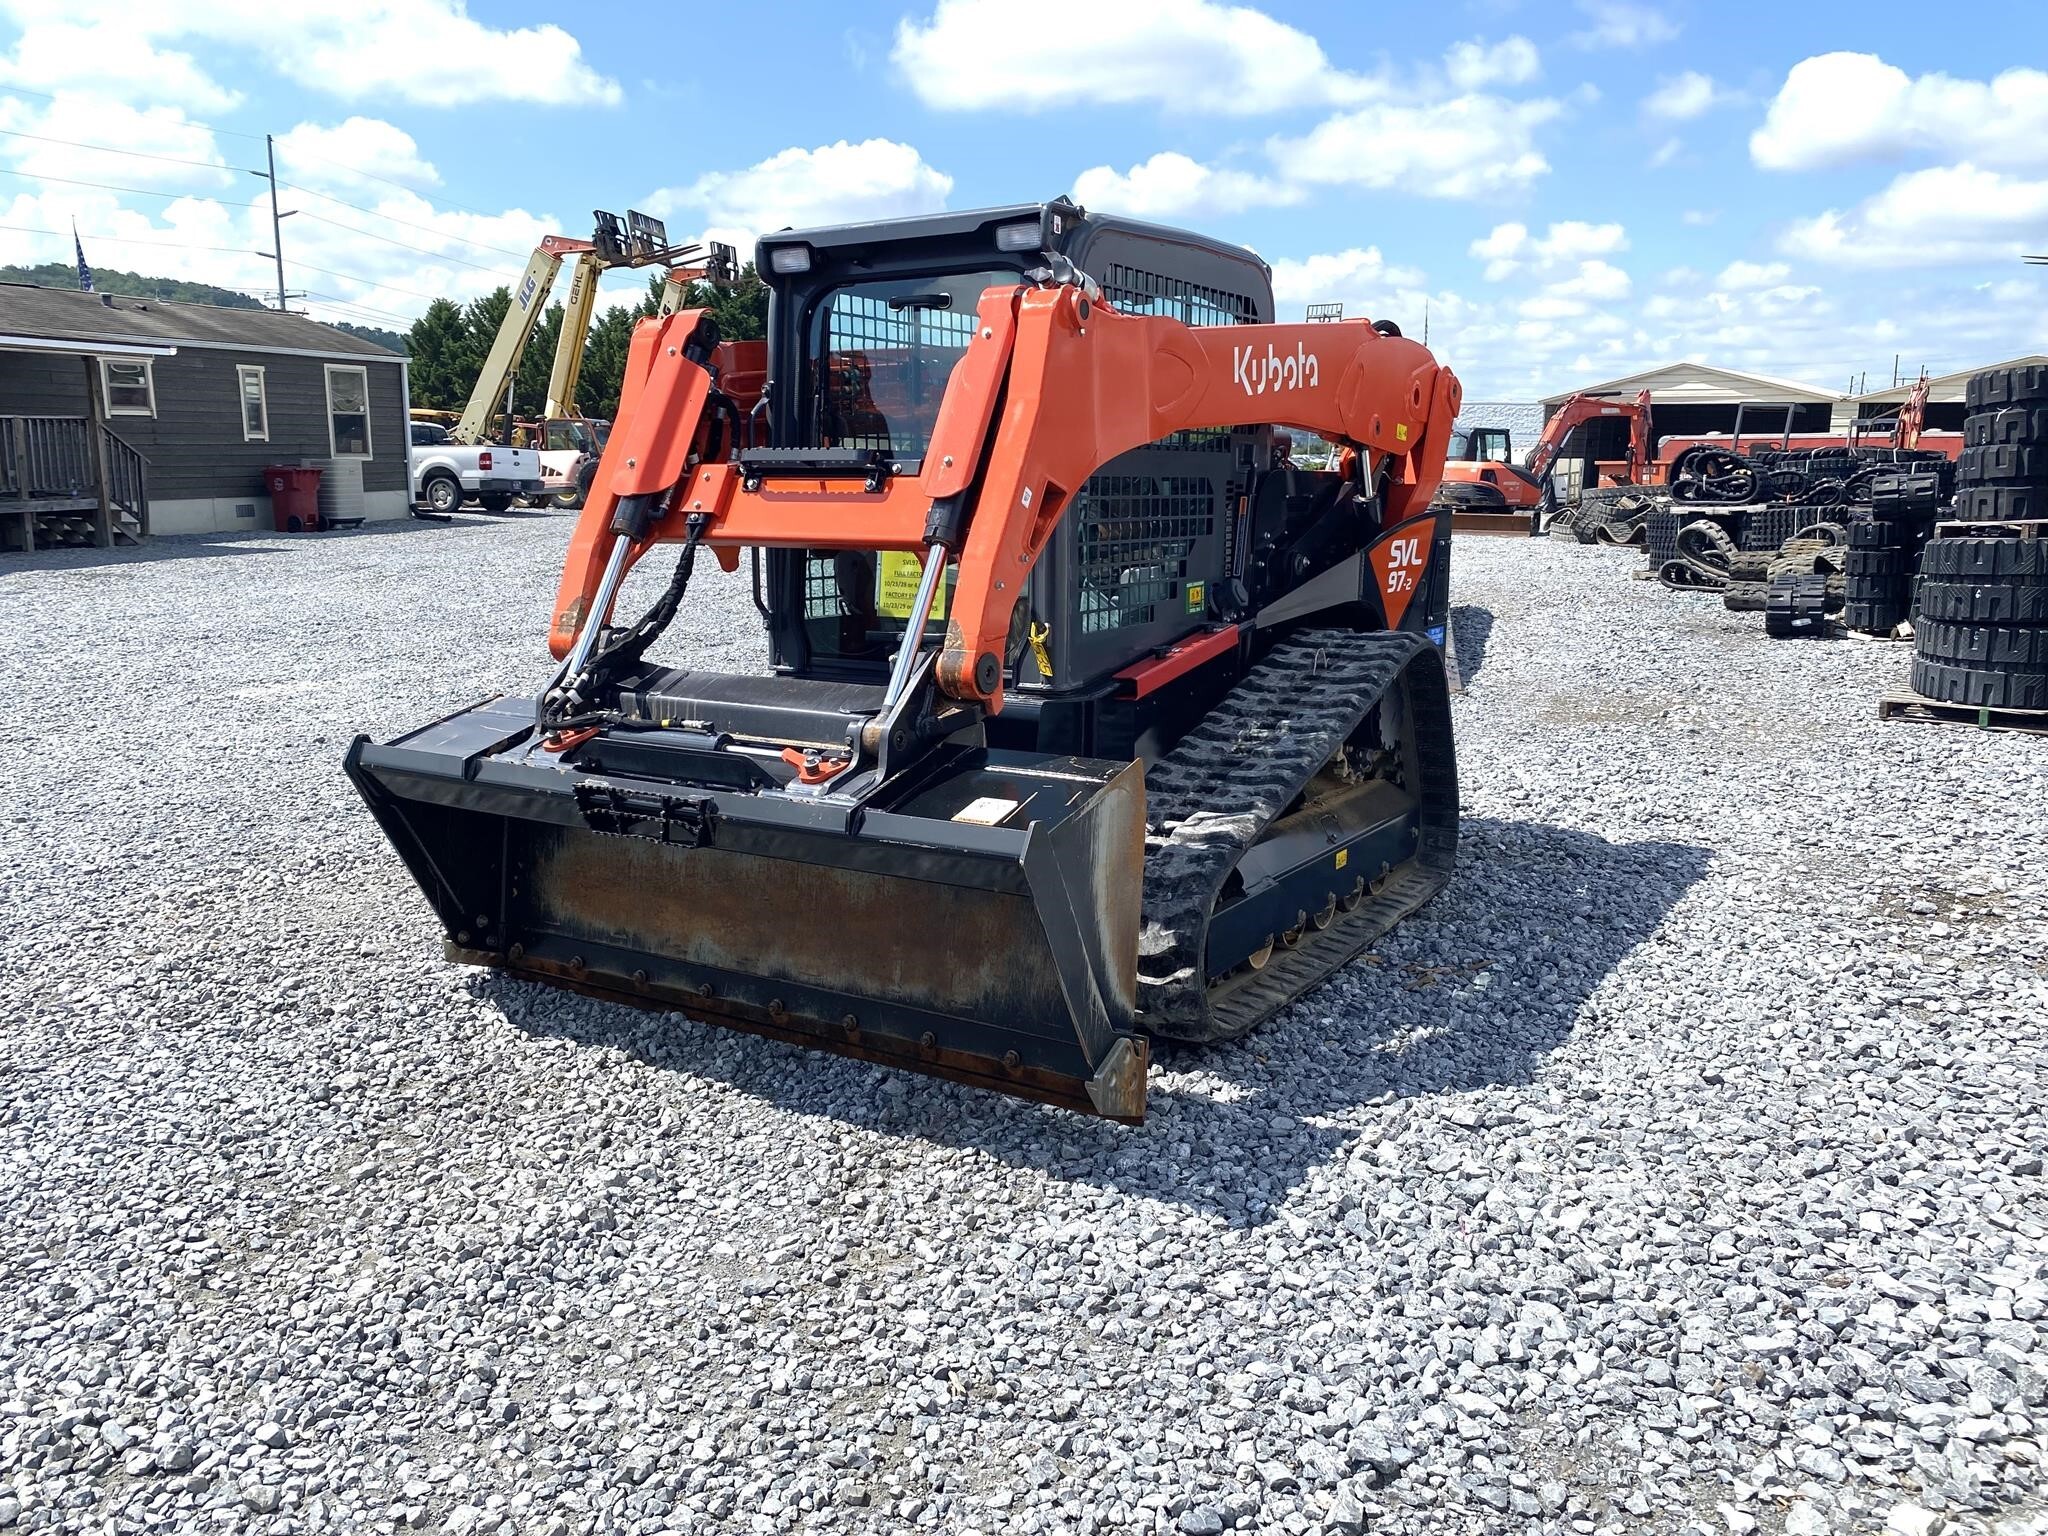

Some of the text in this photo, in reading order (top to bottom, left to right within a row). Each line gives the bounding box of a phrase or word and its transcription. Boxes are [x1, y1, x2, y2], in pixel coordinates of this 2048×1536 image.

[518, 276, 537, 311] JLG
[570, 272, 583, 305] GEHL
[1233, 341, 1318, 396] Kubota
[1388, 539, 1422, 568] SVL
[885, 591, 908, 599] FACTORY
[1387, 570, 1412, 593] 97-2
